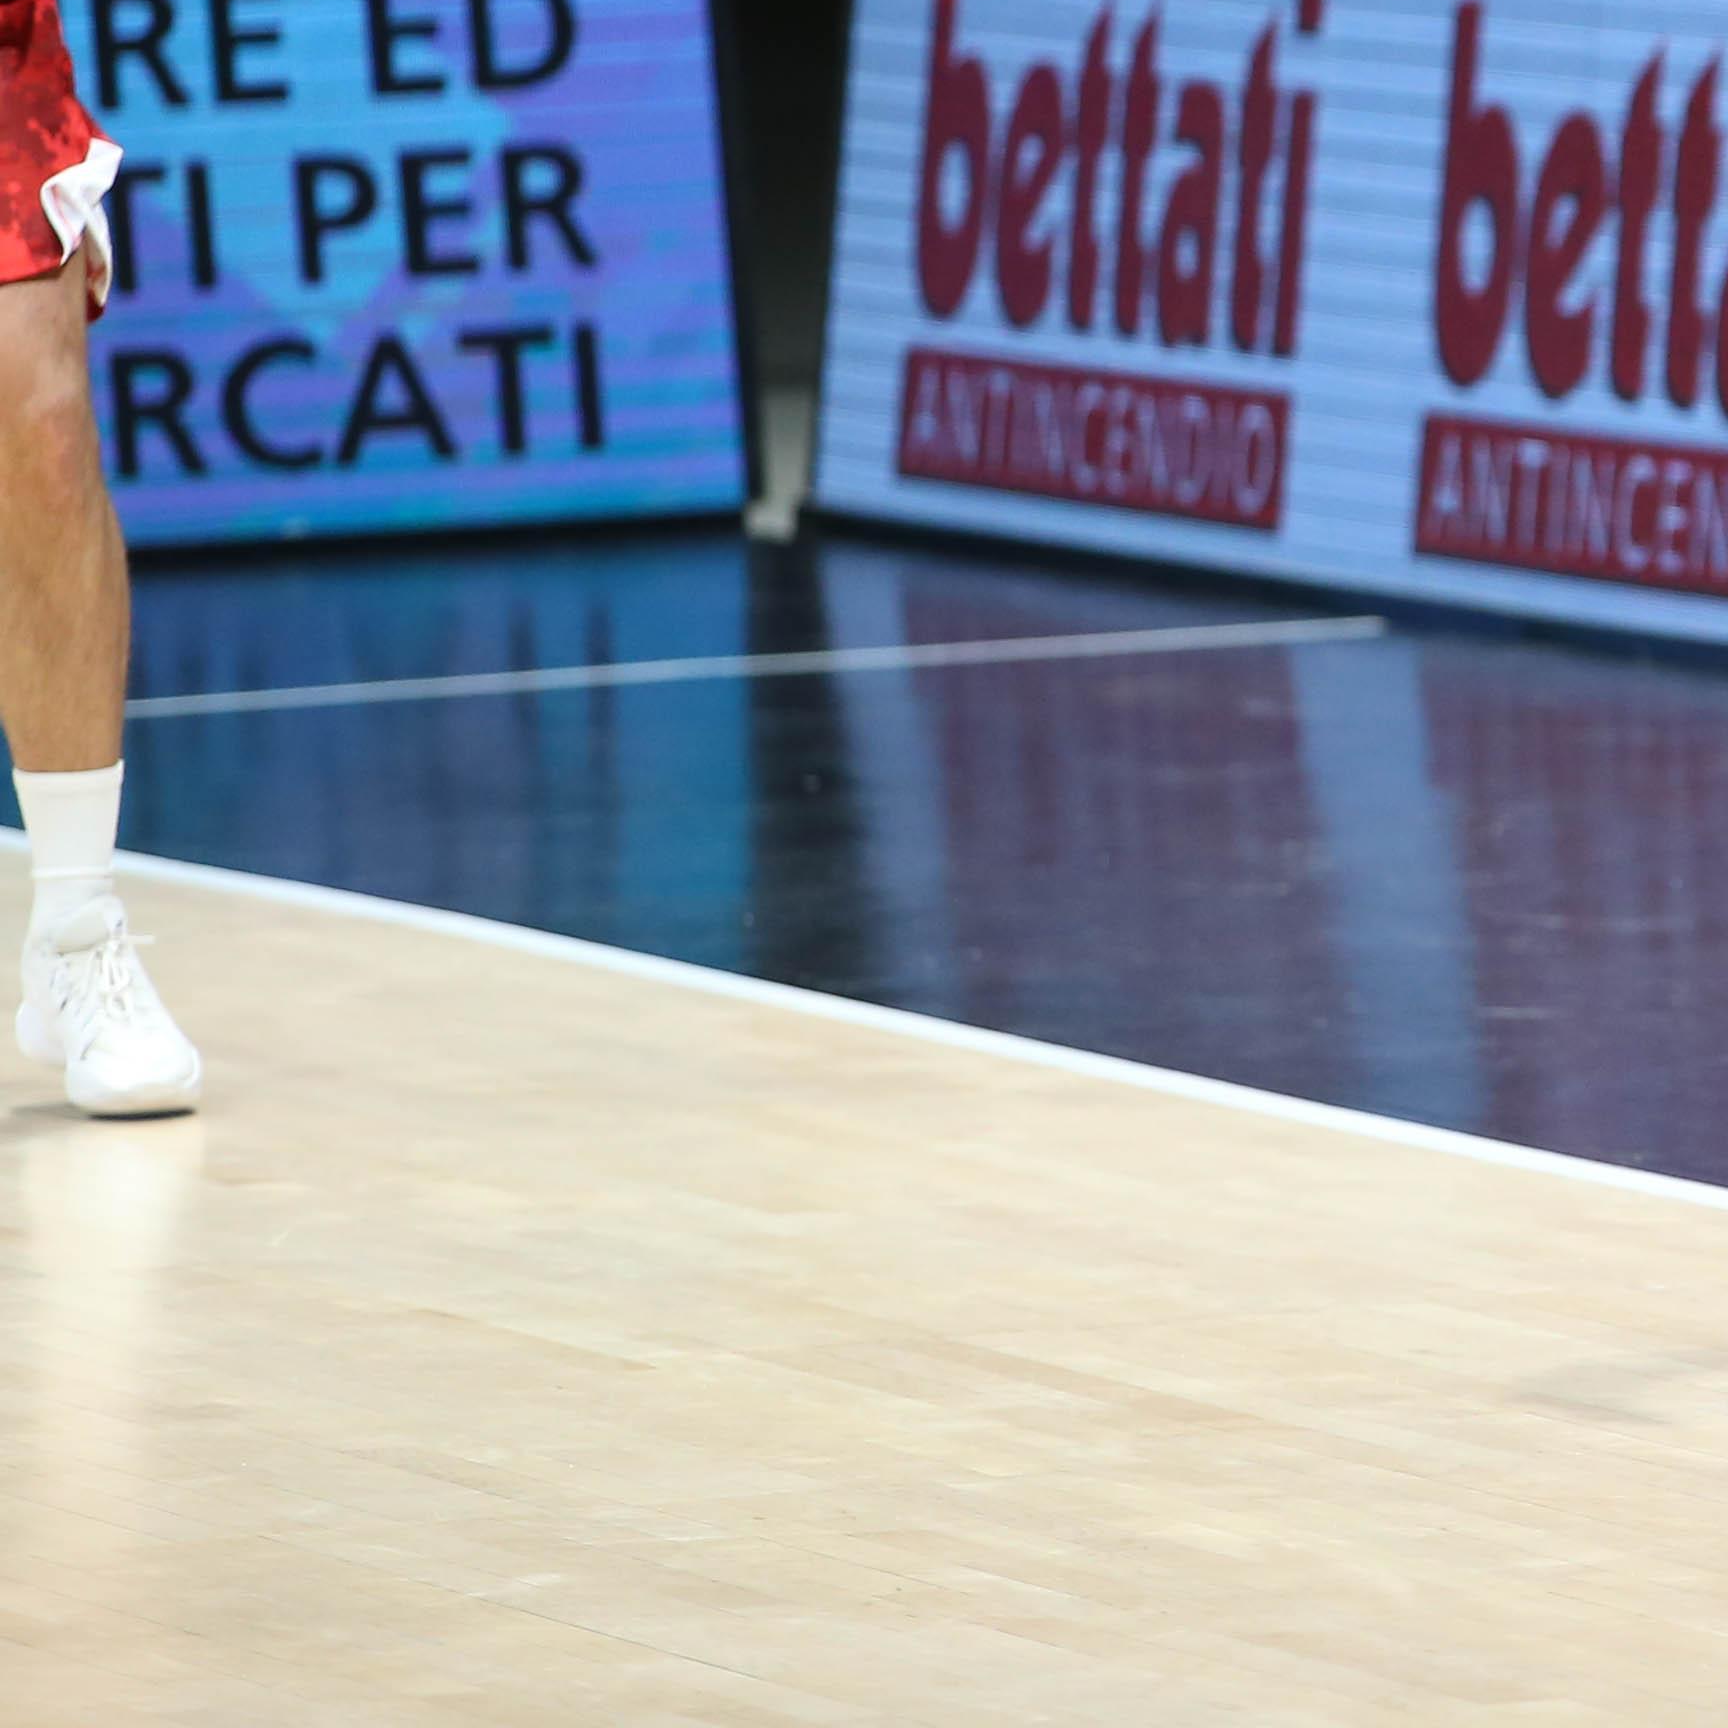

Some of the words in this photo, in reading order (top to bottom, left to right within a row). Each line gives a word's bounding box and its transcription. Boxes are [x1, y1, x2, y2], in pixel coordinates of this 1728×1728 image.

[292, 140, 598, 286] PER
[105, 321, 608, 485] RCATI
[900, 360, 1277, 517] ANTINCENDIO
